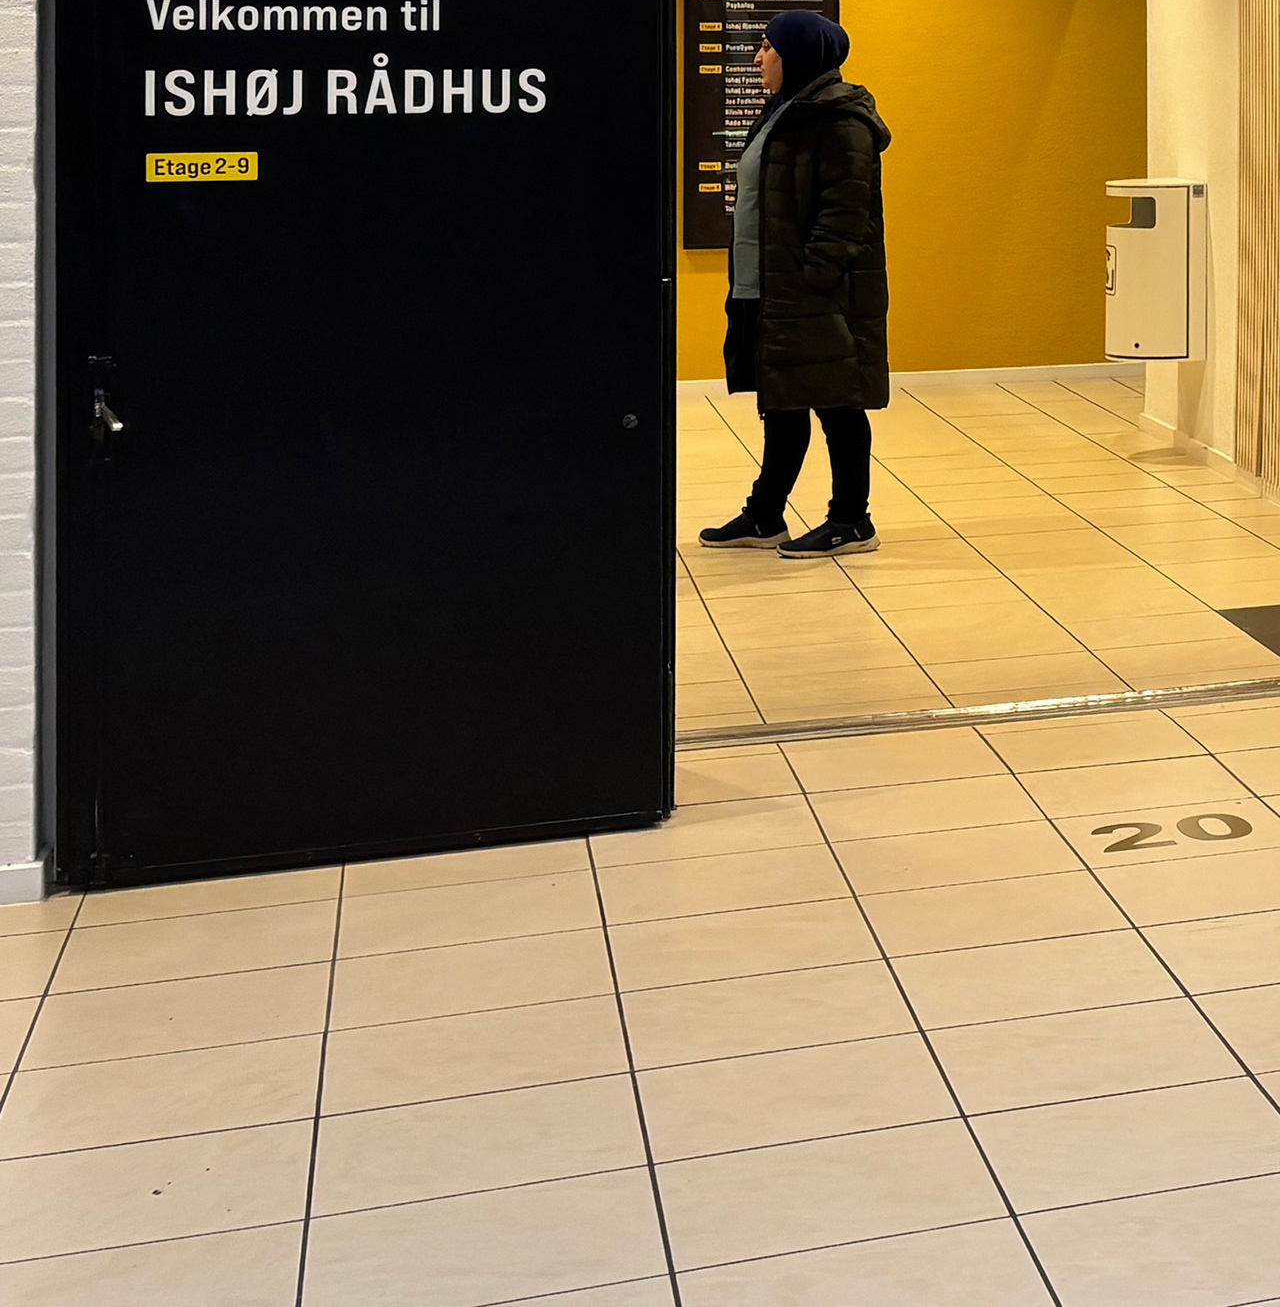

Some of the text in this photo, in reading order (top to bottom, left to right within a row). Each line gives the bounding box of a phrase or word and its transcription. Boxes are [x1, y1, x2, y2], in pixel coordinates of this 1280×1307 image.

[145, 53, 546, 116] ISHØJ RÅDHUS
[155, 157, 249, 178] Etage 2-9
[1091, 813, 1253, 853] 20
